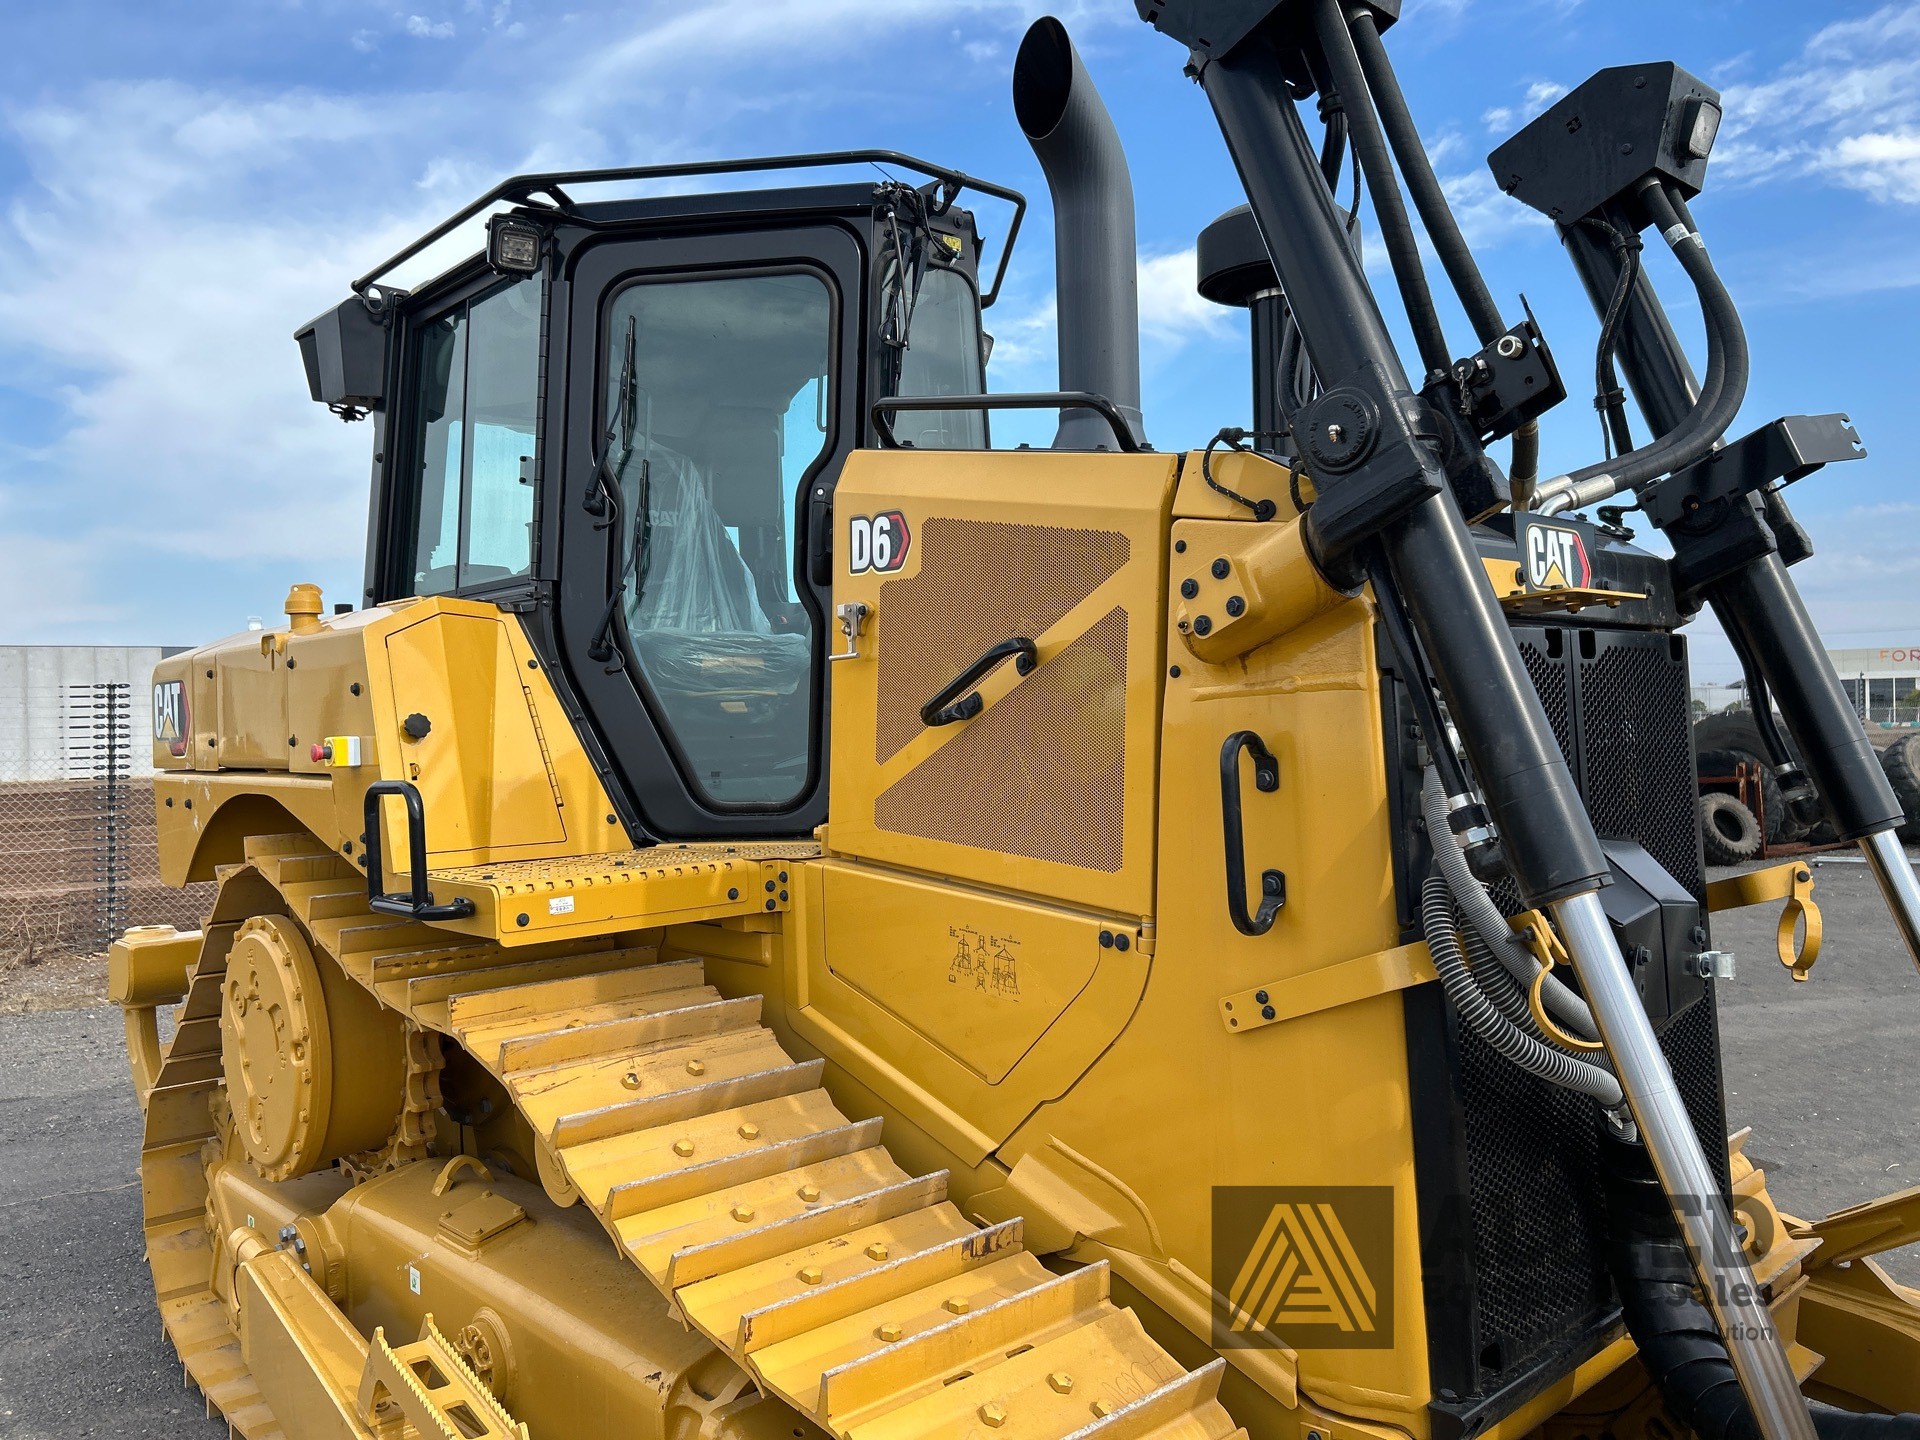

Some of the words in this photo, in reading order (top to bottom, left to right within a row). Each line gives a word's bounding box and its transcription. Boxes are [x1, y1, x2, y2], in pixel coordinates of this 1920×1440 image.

[852, 515, 891, 570] D6
[1528, 526, 1573, 588] CAT
[154, 682, 181, 739] CAT
